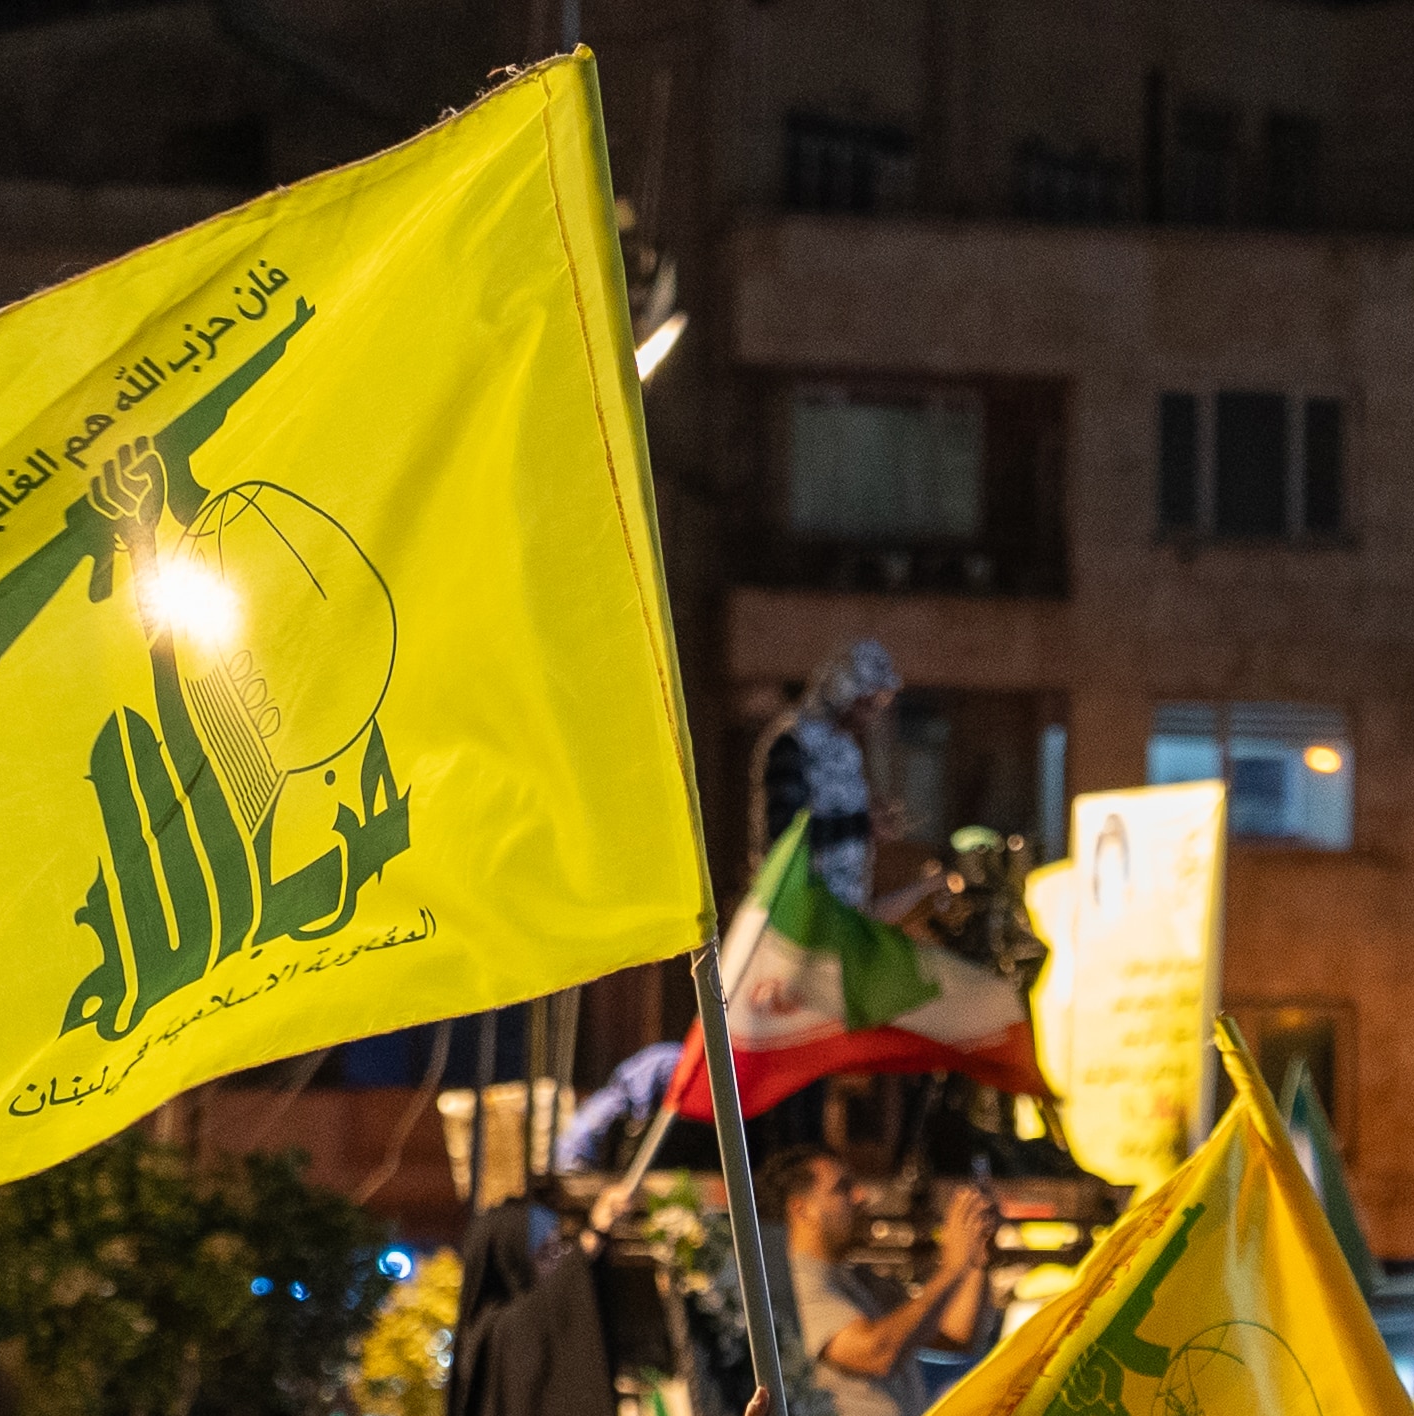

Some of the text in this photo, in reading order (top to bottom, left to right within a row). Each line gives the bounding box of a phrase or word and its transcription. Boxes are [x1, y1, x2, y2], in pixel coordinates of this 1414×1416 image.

[167, 315, 237, 373] حزب
[63, 413, 115, 470] هم
[8, 1065, 109, 1117] لبنان
